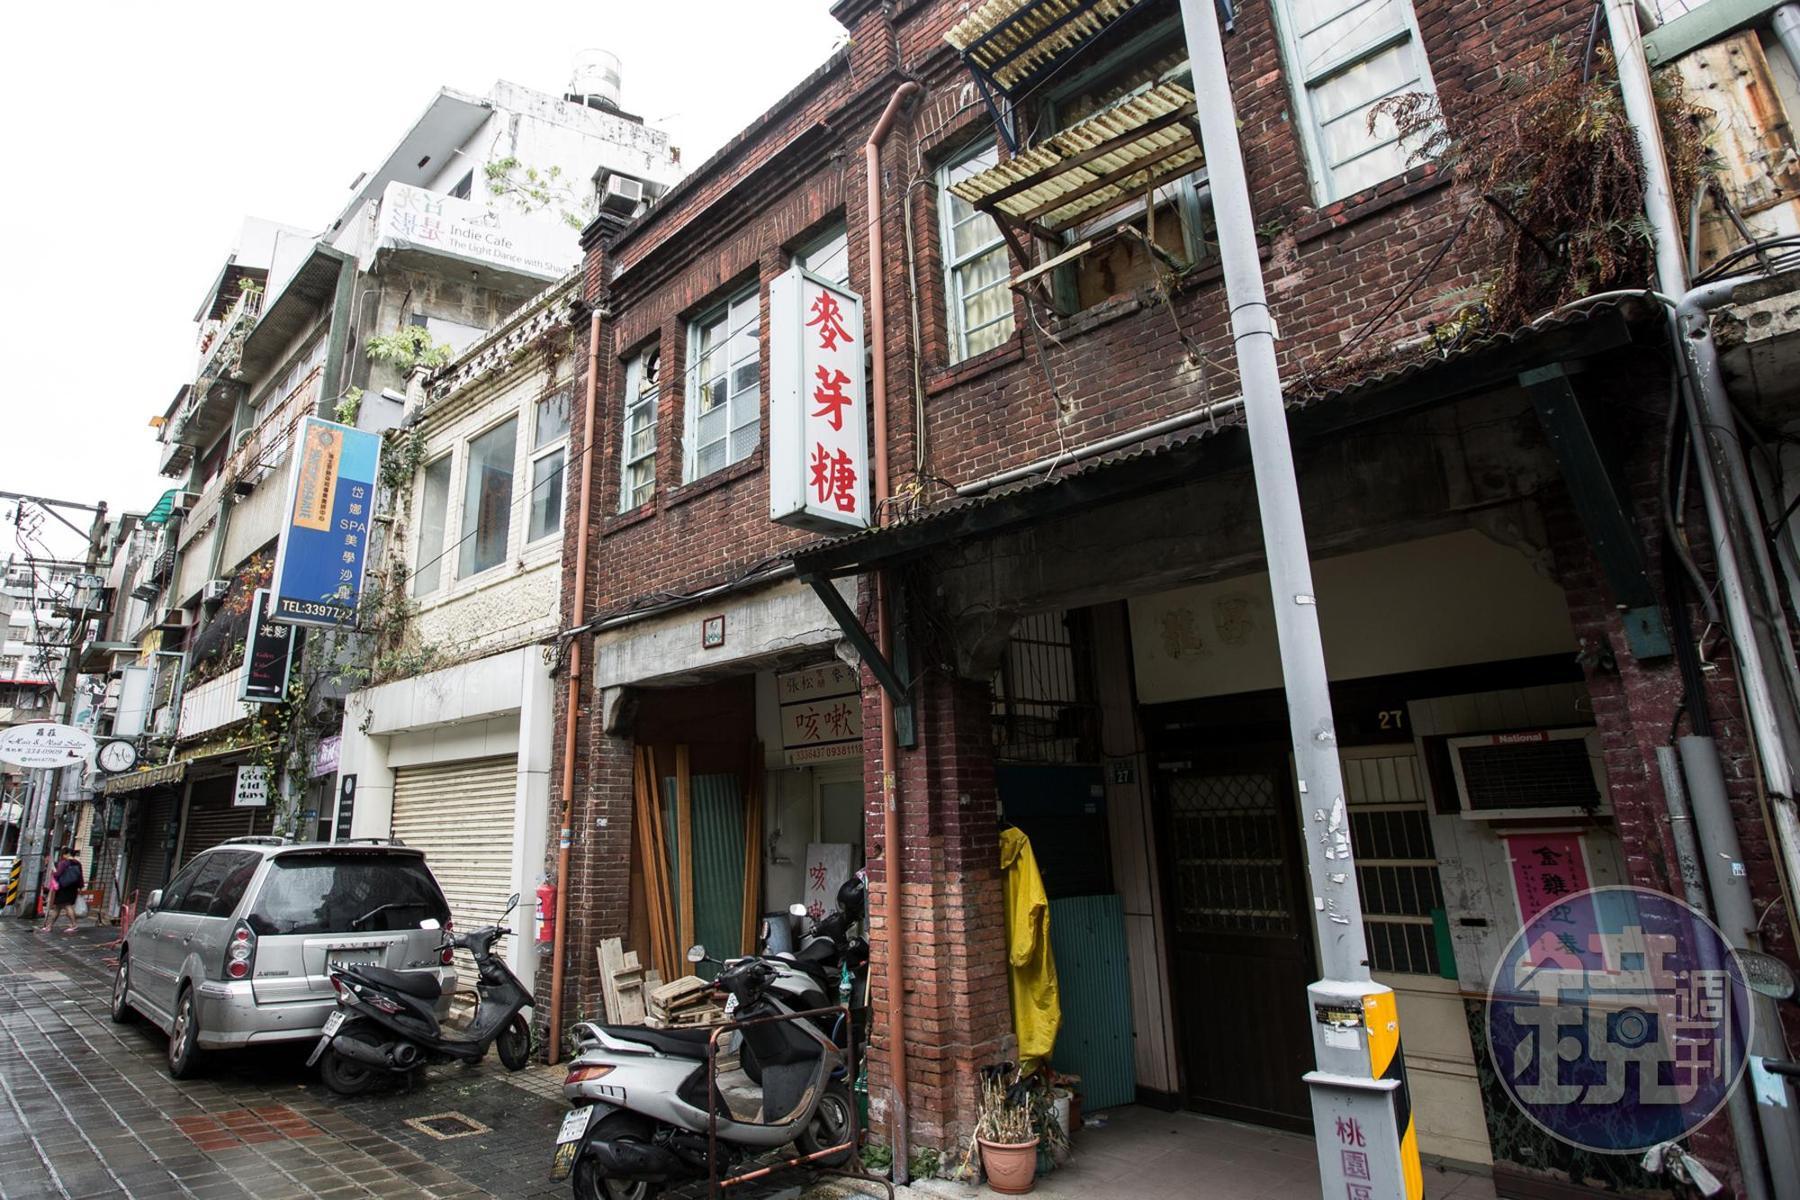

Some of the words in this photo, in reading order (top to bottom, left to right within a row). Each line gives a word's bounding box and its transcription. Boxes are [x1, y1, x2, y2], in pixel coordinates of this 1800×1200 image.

[450, 224, 482, 242] Indie
[485, 234, 513, 249] Cafe
[450, 239, 467, 250] The
[468, 243, 491, 258] Light
[493, 248, 522, 263] Dance
[524, 255, 543, 268] with
[805, 290, 857, 513] 麥芽糖
[260, 624, 288, 639] 光影
[795, 703, 855, 740] 咳嗽
[1378, 710, 1402, 729] 27
[1499, 732, 1542, 744] National
[240, 782, 260, 790] old
[238, 791, 265, 803] days
